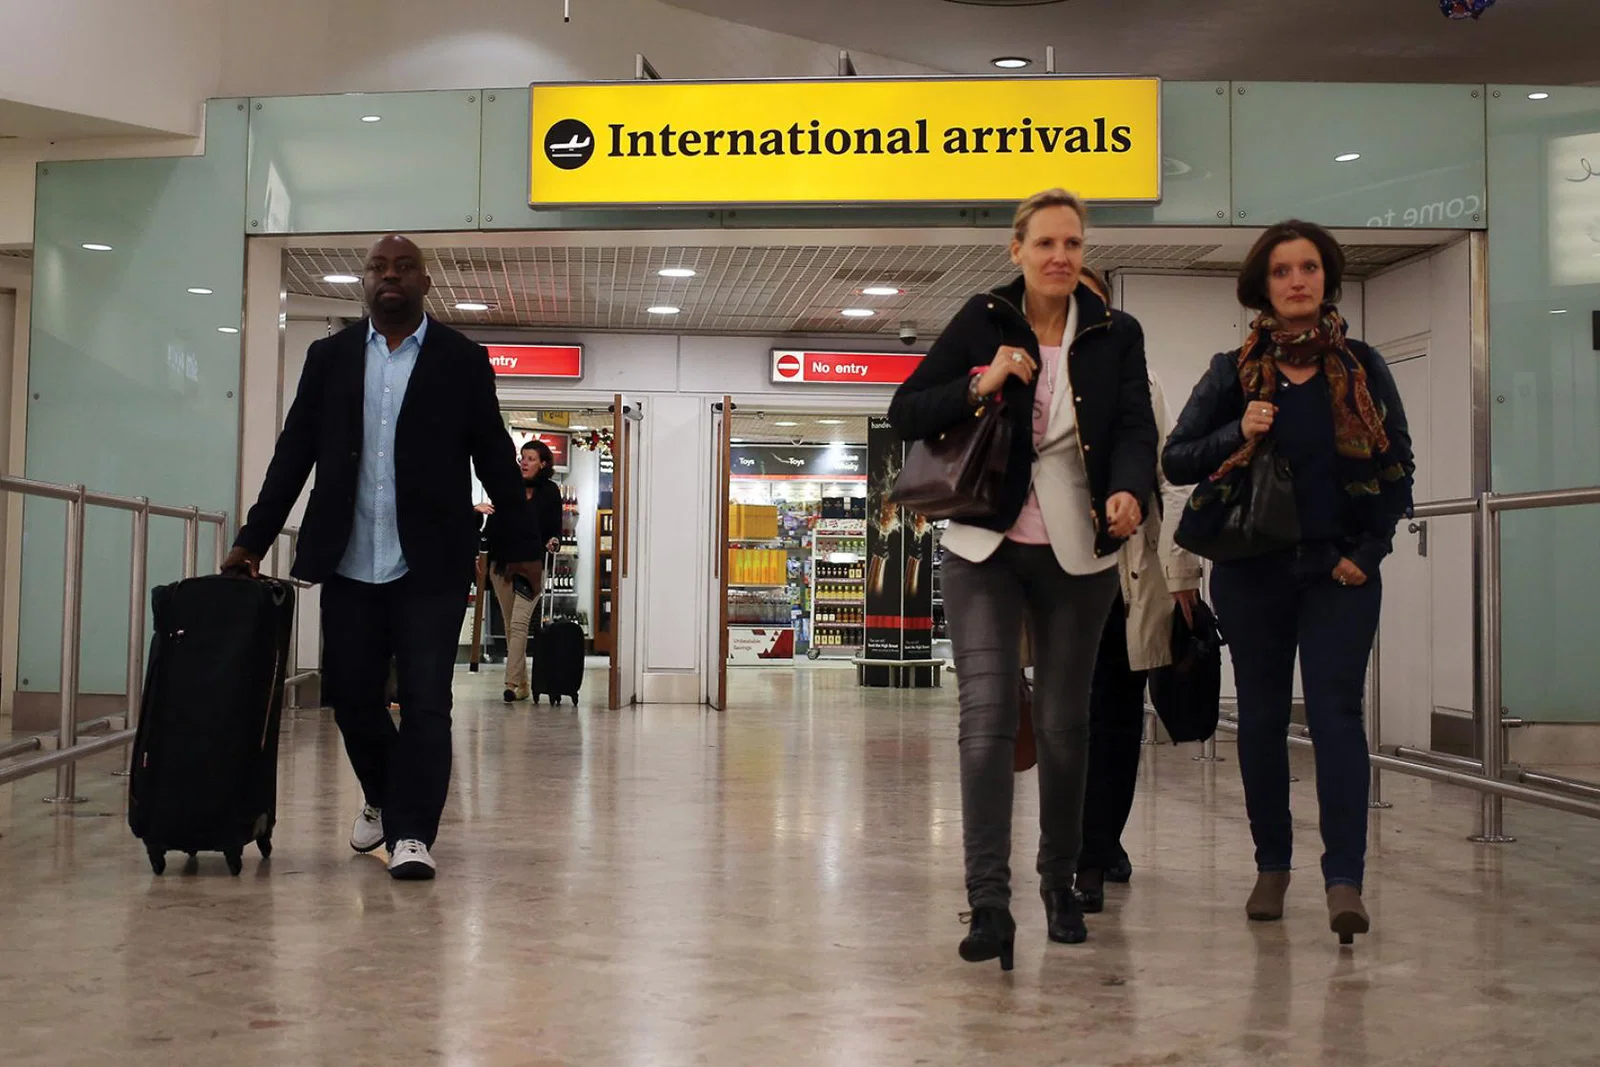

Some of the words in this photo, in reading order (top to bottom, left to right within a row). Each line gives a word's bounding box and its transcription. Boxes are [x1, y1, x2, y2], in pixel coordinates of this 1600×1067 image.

[608, 119, 929, 157] International
[943, 117, 1132, 154] arrivals
[812, 362, 830, 373] No
[835, 363, 868, 376] entry
[738, 457, 755, 466] Toys
[788, 457, 805, 466] Toys
